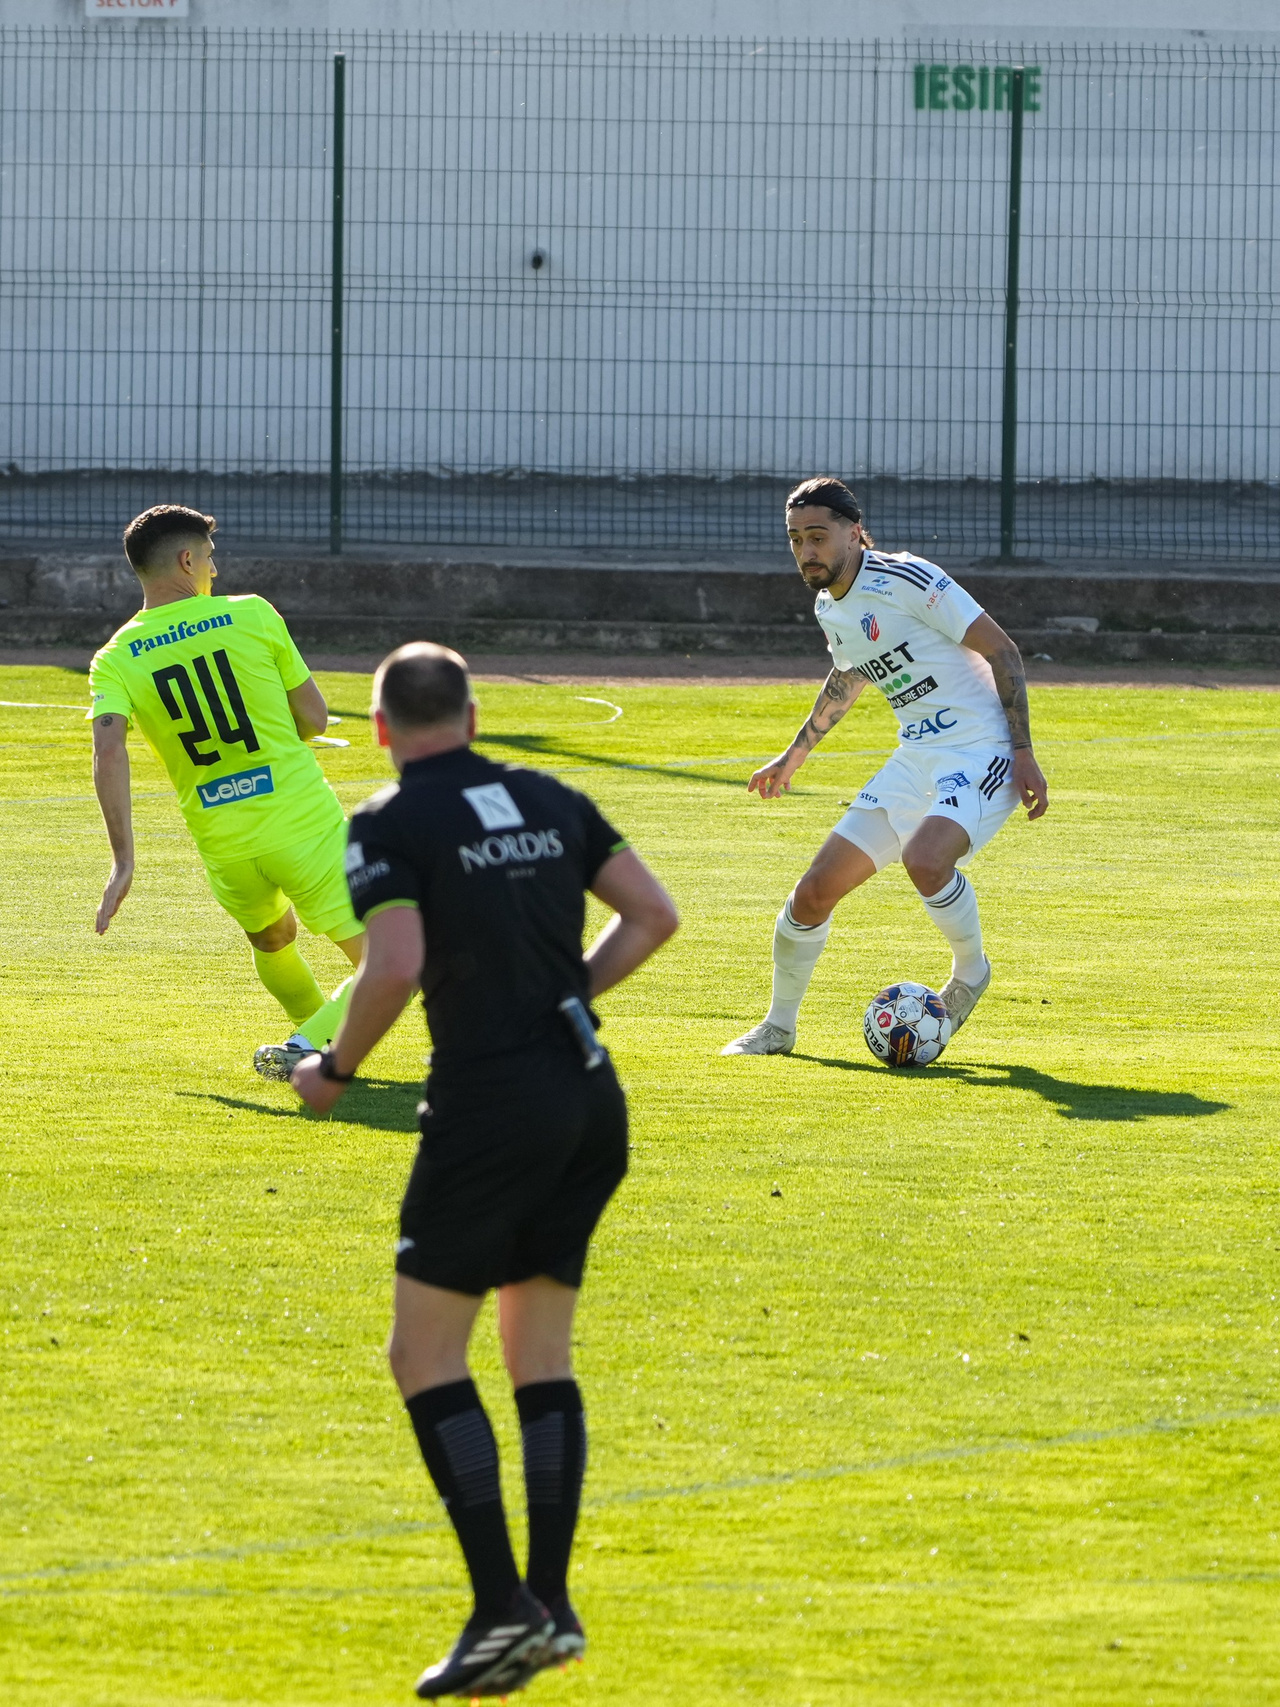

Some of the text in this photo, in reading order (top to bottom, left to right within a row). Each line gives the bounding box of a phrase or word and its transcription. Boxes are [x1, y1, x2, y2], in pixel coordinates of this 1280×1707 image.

[914, 64, 1041, 111] IESIRE
[128, 613, 233, 657] Panifcom
[857, 641, 915, 683] NIBET
[152, 649, 260, 766] 24
[860, 791, 879, 804] stra
[458, 828, 564, 875] NORDIS
